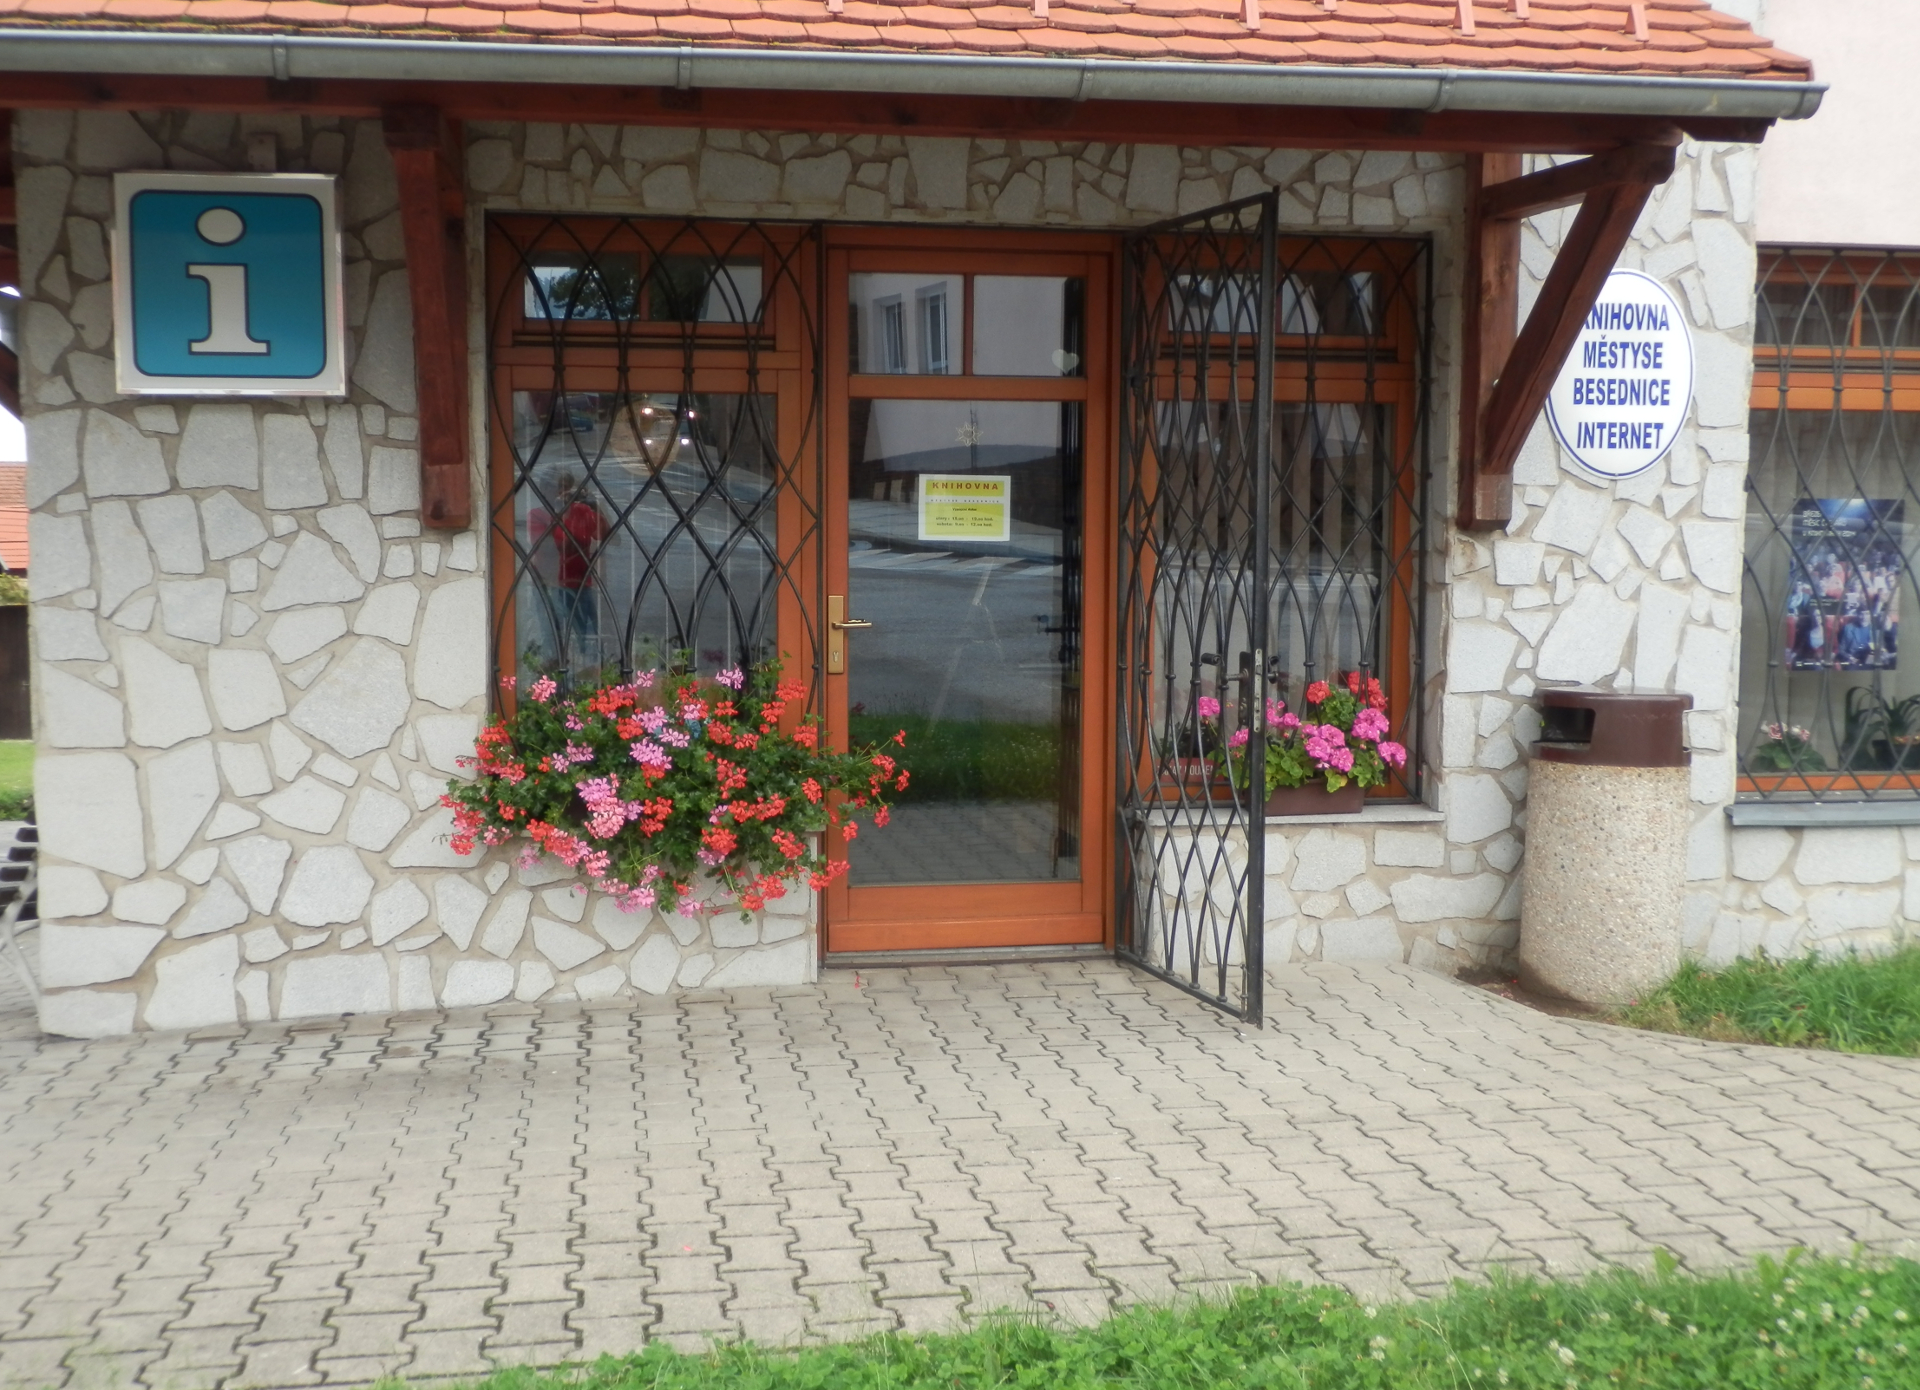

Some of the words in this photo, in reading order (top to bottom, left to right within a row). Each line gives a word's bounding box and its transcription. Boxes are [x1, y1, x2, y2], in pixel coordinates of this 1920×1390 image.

[1583, 334, 1663, 369] MĚSTYSE
[1573, 378, 1670, 406] BESEDNICE
[1576, 422, 1664, 449] INTERNET
[932, 482, 998, 490] KNIHOVNA
